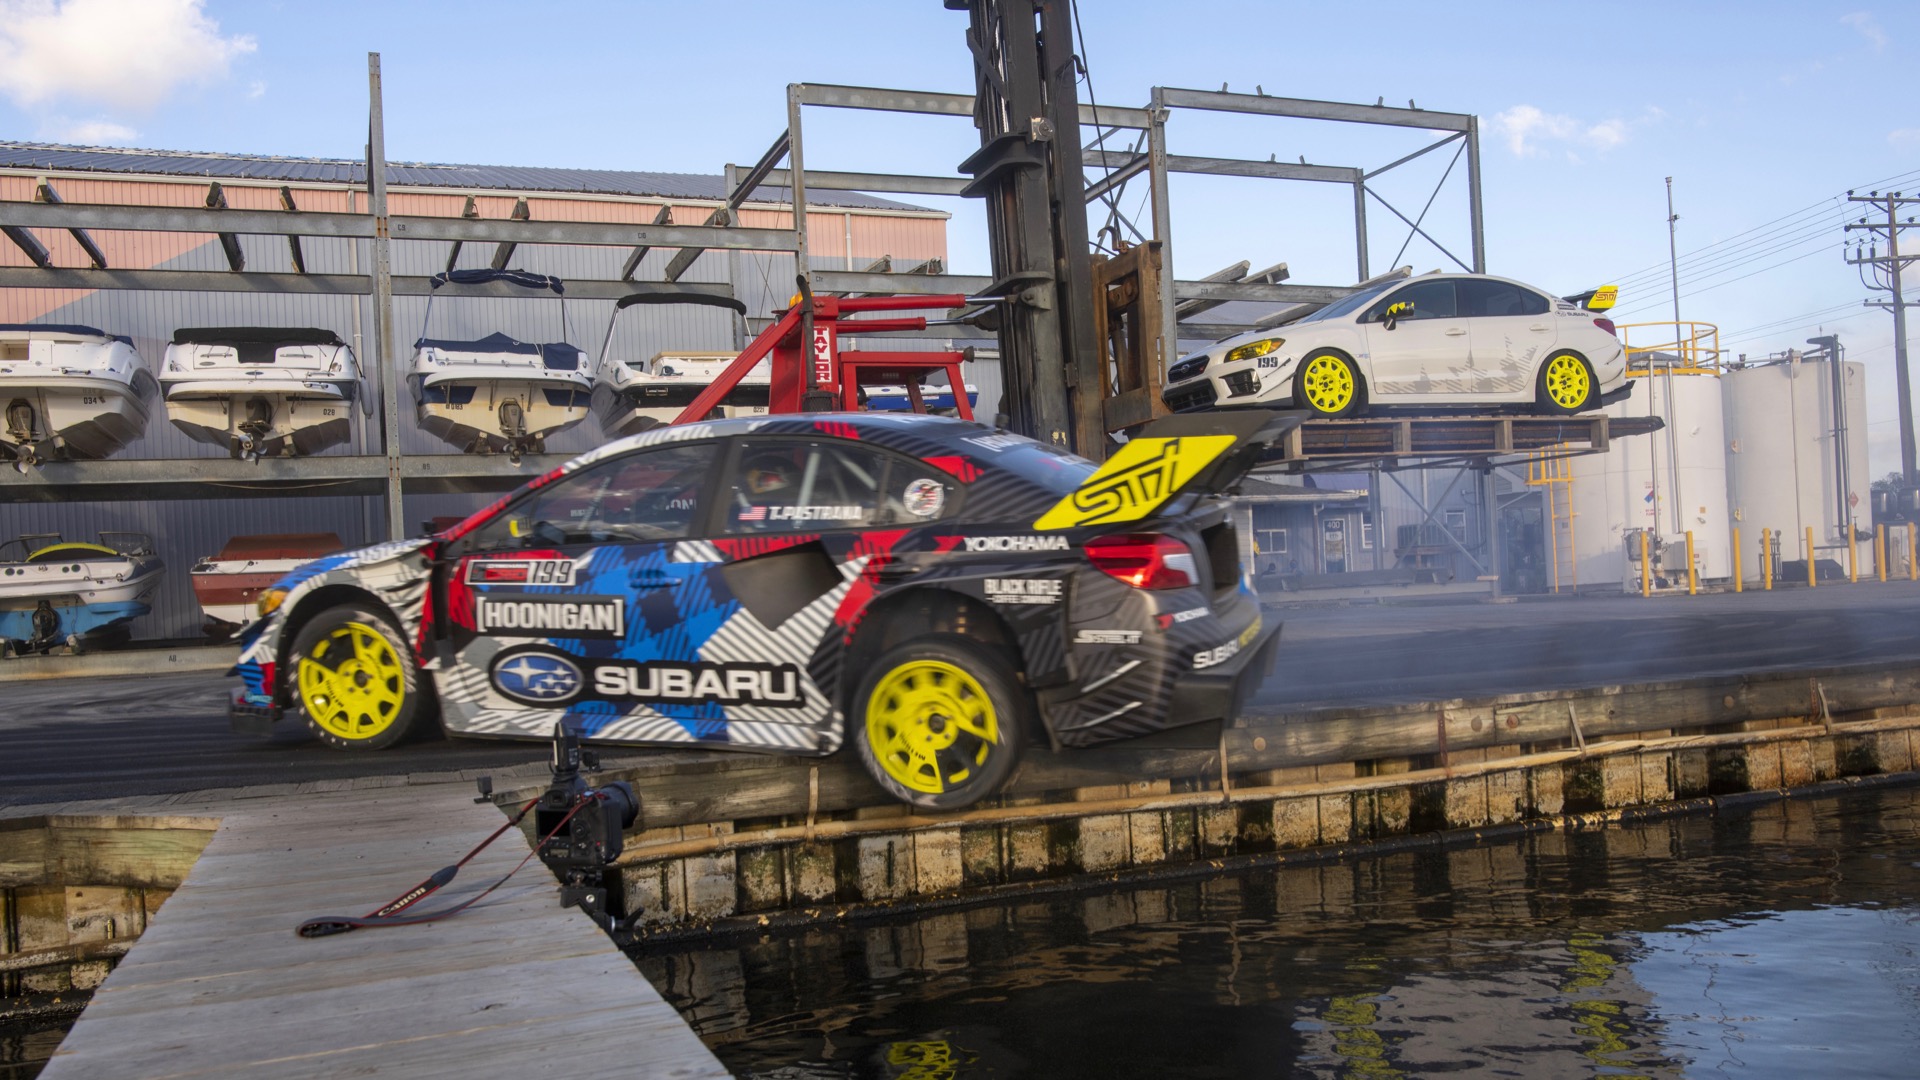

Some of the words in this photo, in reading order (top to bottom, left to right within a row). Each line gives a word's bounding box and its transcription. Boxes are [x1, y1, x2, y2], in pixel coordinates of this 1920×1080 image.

[814, 327, 832, 382] TAYLOR
[1256, 357, 1279, 369] 199
[83, 396, 98, 405] 034
[1327, 521, 1341, 529] 400
[963, 535, 1071, 552] YOKOHAMA
[532, 560, 573, 584] 199
[983, 578, 1026, 595] BLACK
[1026, 579, 1063, 596] RIFLE
[594, 665, 797, 702] SUBARU
[378, 887, 427, 917] Canon
